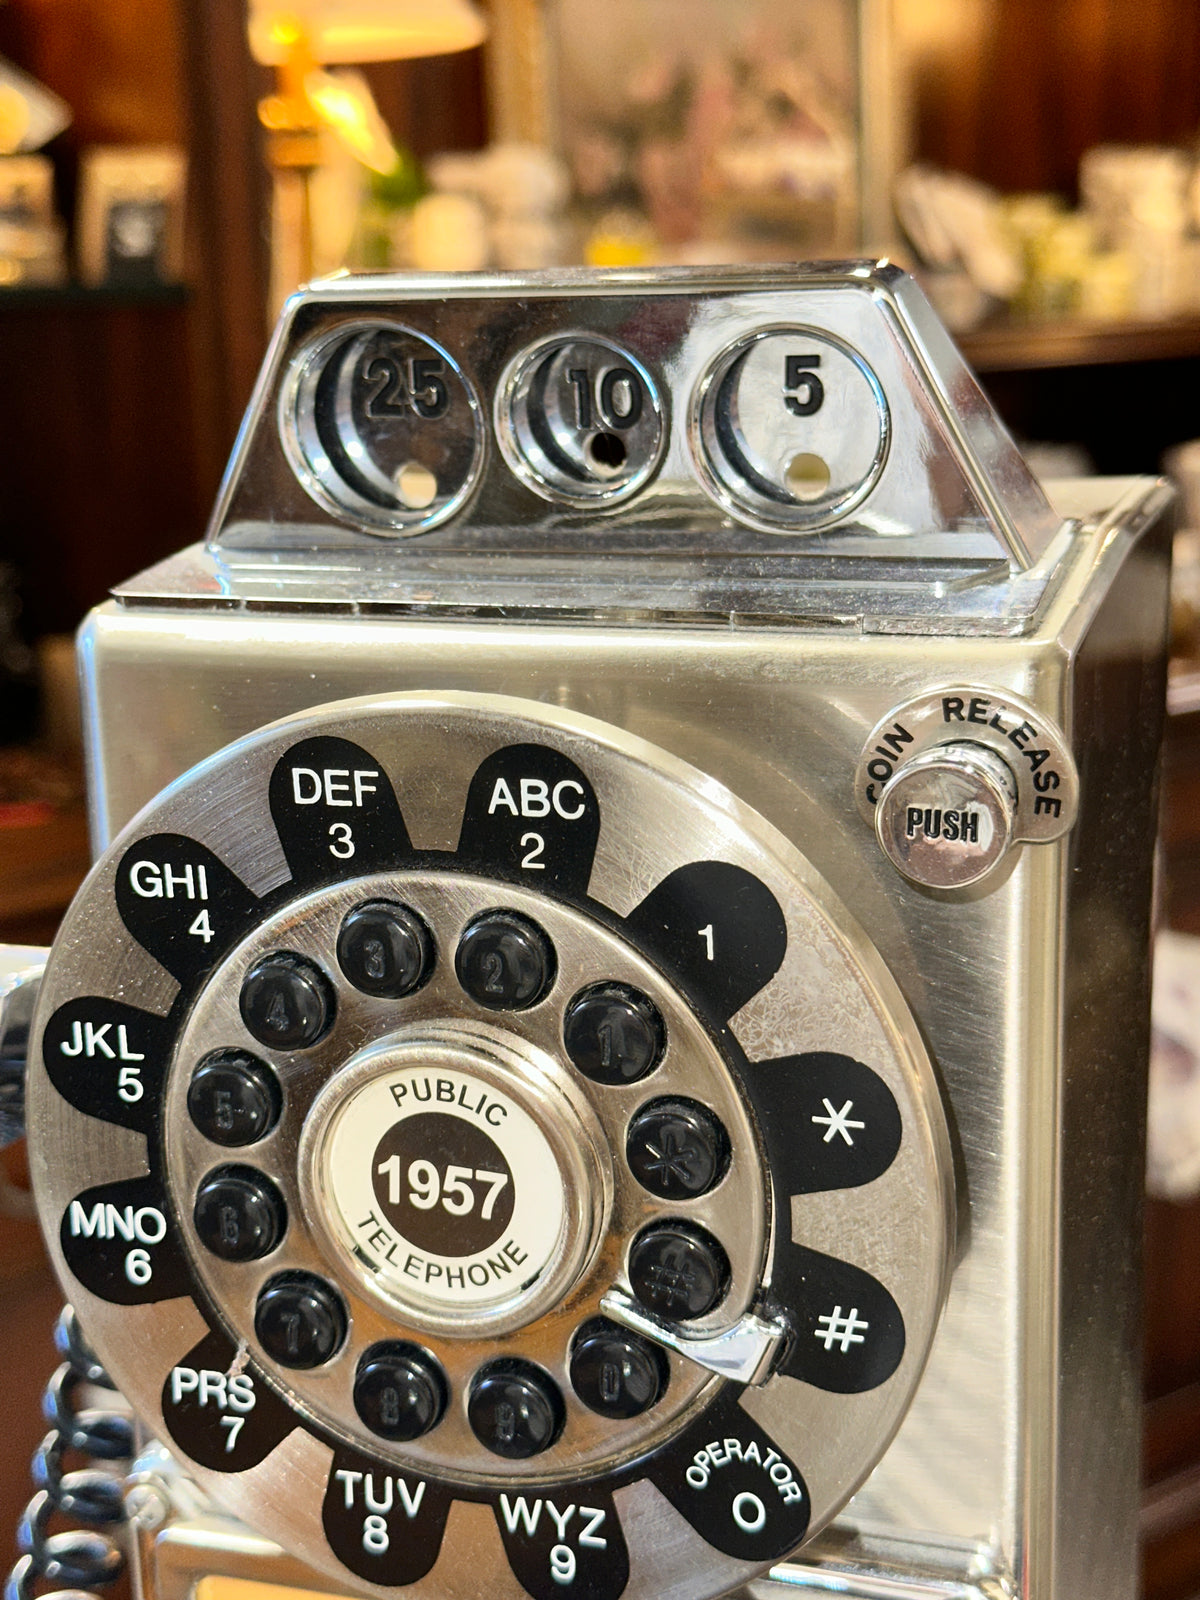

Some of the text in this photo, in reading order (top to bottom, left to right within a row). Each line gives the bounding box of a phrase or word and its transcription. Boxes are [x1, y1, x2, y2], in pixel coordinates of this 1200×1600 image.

[363, 359, 447, 419] 25
[565, 367, 643, 431] 10
[783, 354, 826, 417] 5
[942, 697, 1061, 818] RELEASE
[292, 768, 379, 807] DEF
[488, 777, 586, 820] ABC
[328, 822, 356, 859] 3
[906, 807, 979, 842] PUSH
[520, 832, 546, 870] 2
[130, 860, 209, 900] GHI
[188, 909, 216, 943] 4
[697, 923, 714, 961] 1
[482, 952, 504, 993] 2
[60, 1020, 145, 1060] JKL
[118, 1067, 144, 1103] 5
[389, 1078, 508, 1126] PUBLIC
[377, 1154, 508, 1220] 1957
[69, 1200, 167, 1244] MNO
[125, 1249, 152, 1286] 6
[358, 1210, 529, 1288] TELEPHONE
[170, 1366, 257, 1412] PRS
[220, 1416, 245, 1452] 7
[685, 1438, 802, 1505] OPERATOR
[335, 1469, 426, 1518] TUV
[362, 1515, 390, 1554] 8
[500, 1493, 607, 1548] WYZ
[550, 1544, 577, 1584] 9
